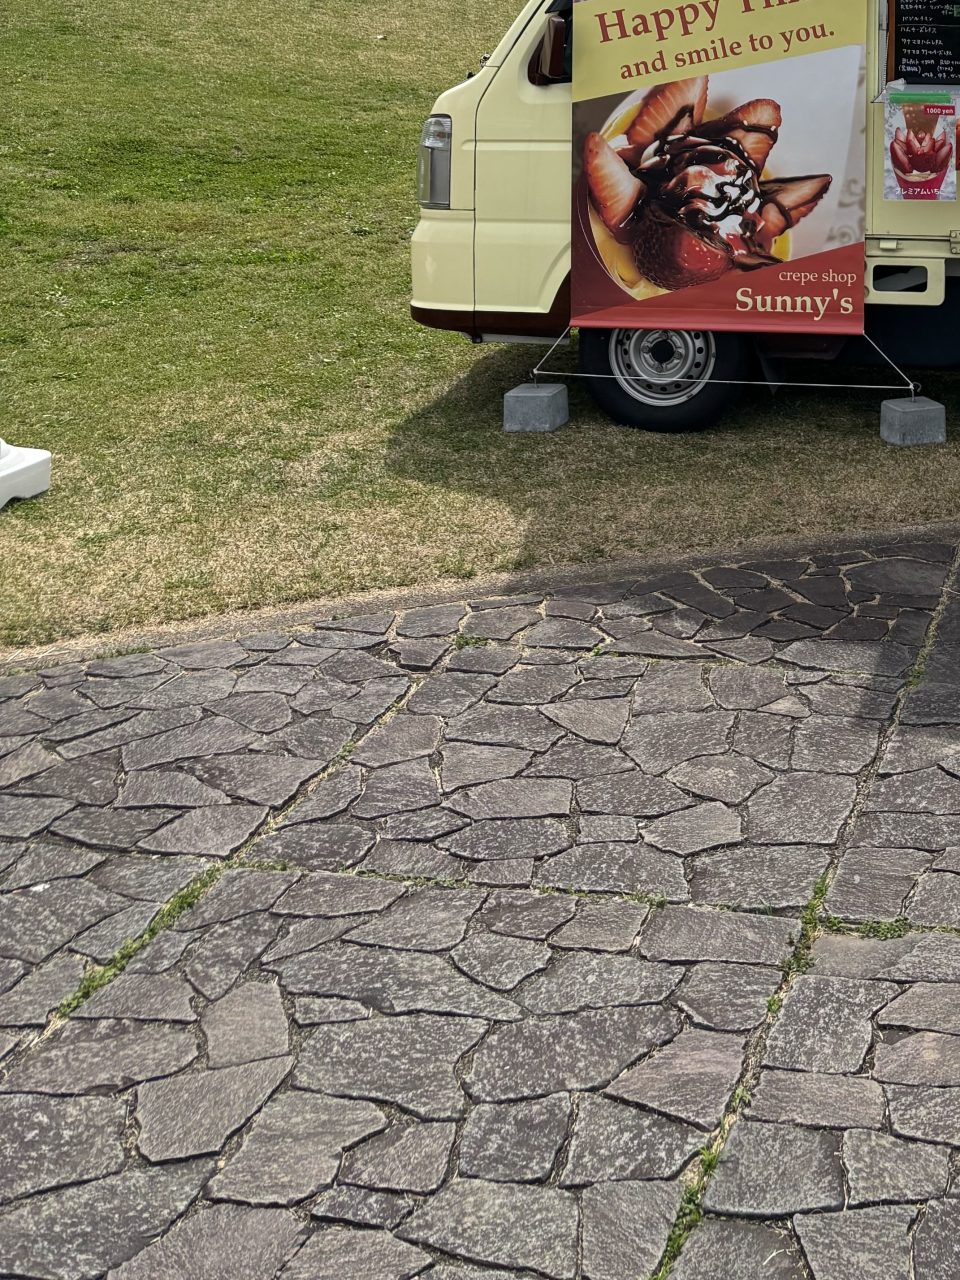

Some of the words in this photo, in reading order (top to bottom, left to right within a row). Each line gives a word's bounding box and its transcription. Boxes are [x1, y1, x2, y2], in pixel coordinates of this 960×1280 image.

[619, 50, 668, 79] and
[675, 38, 743, 69] smile
[748, 31, 773, 52] to
[779, 22, 835, 53] you.
[778, 271, 818, 286] crepe
[821, 268, 857, 287] shop
[735, 286, 854, 320] Sunny's
